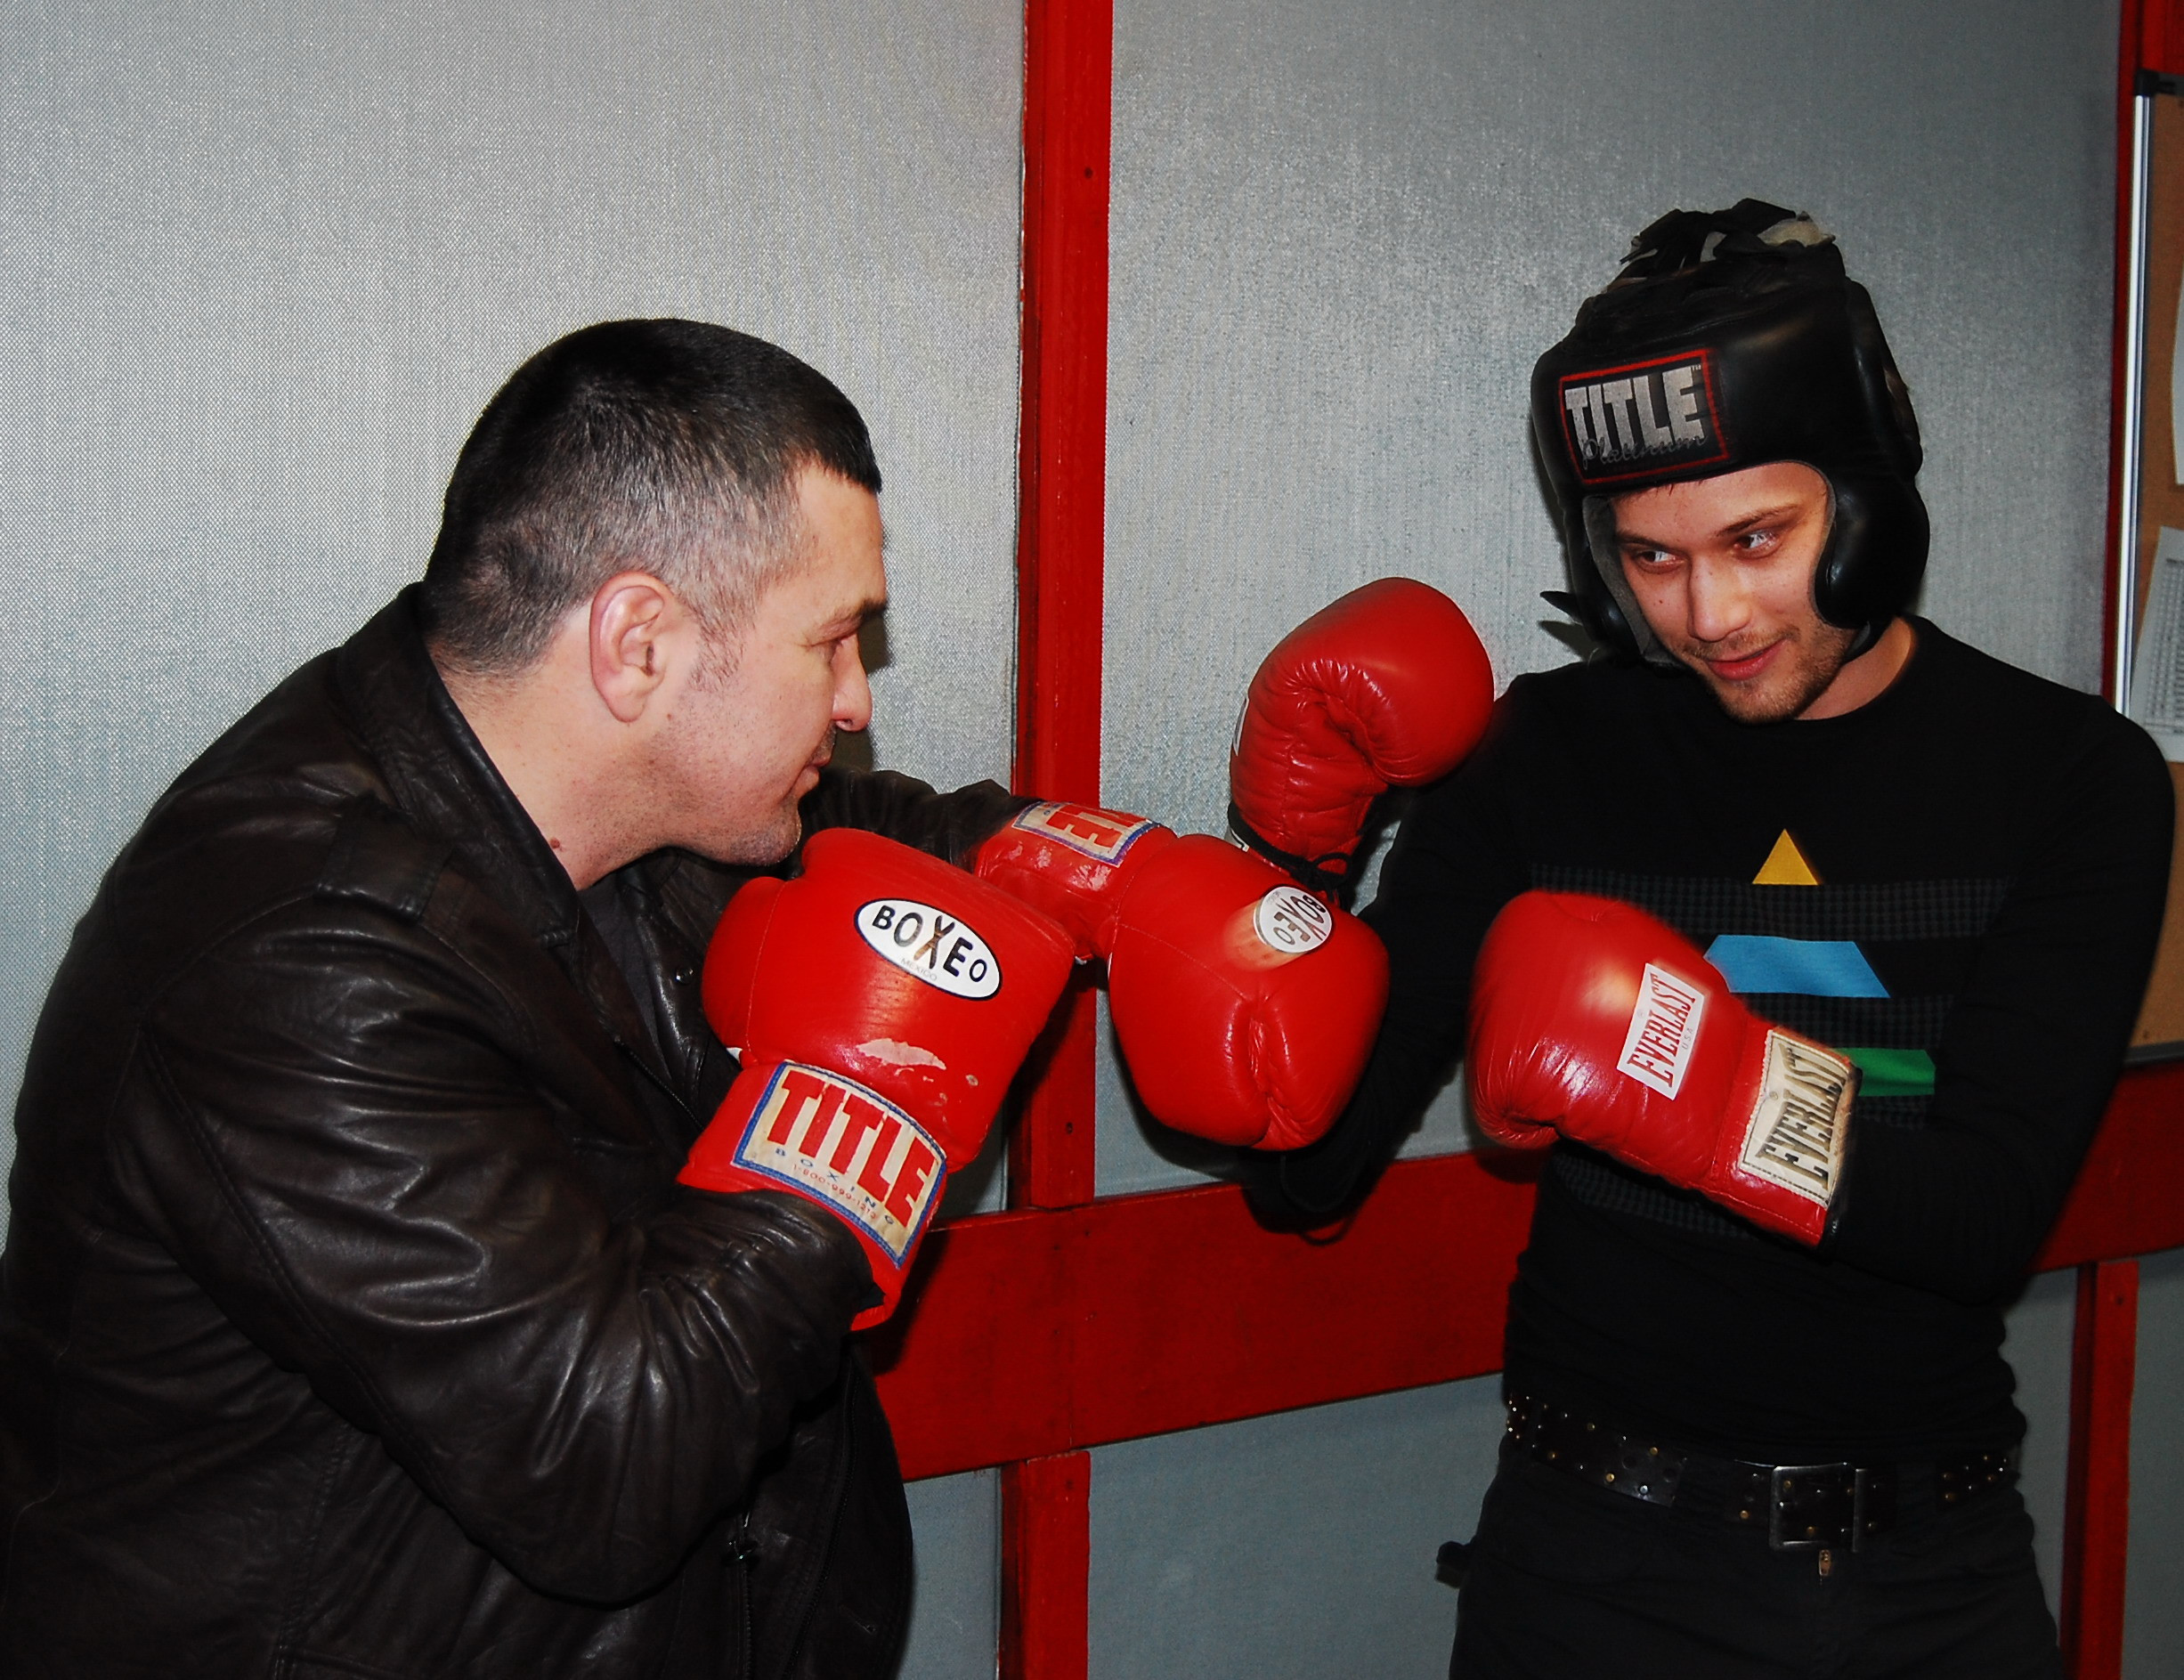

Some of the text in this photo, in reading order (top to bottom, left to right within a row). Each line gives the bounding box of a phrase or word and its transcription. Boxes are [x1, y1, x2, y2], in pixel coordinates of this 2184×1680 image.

[1565, 366, 1705, 457] TITLE
[873, 905, 987, 983] BOXEO
[1273, 895, 1327, 946] BOXEO
[900, 957, 938, 981] MEXICO
[1627, 973, 1696, 1088] EVERLAST
[767, 1070, 936, 1228] TITLE
[1755, 1043, 1847, 1190] EVERLAST
[775, 1148, 895, 1225] BOXING
